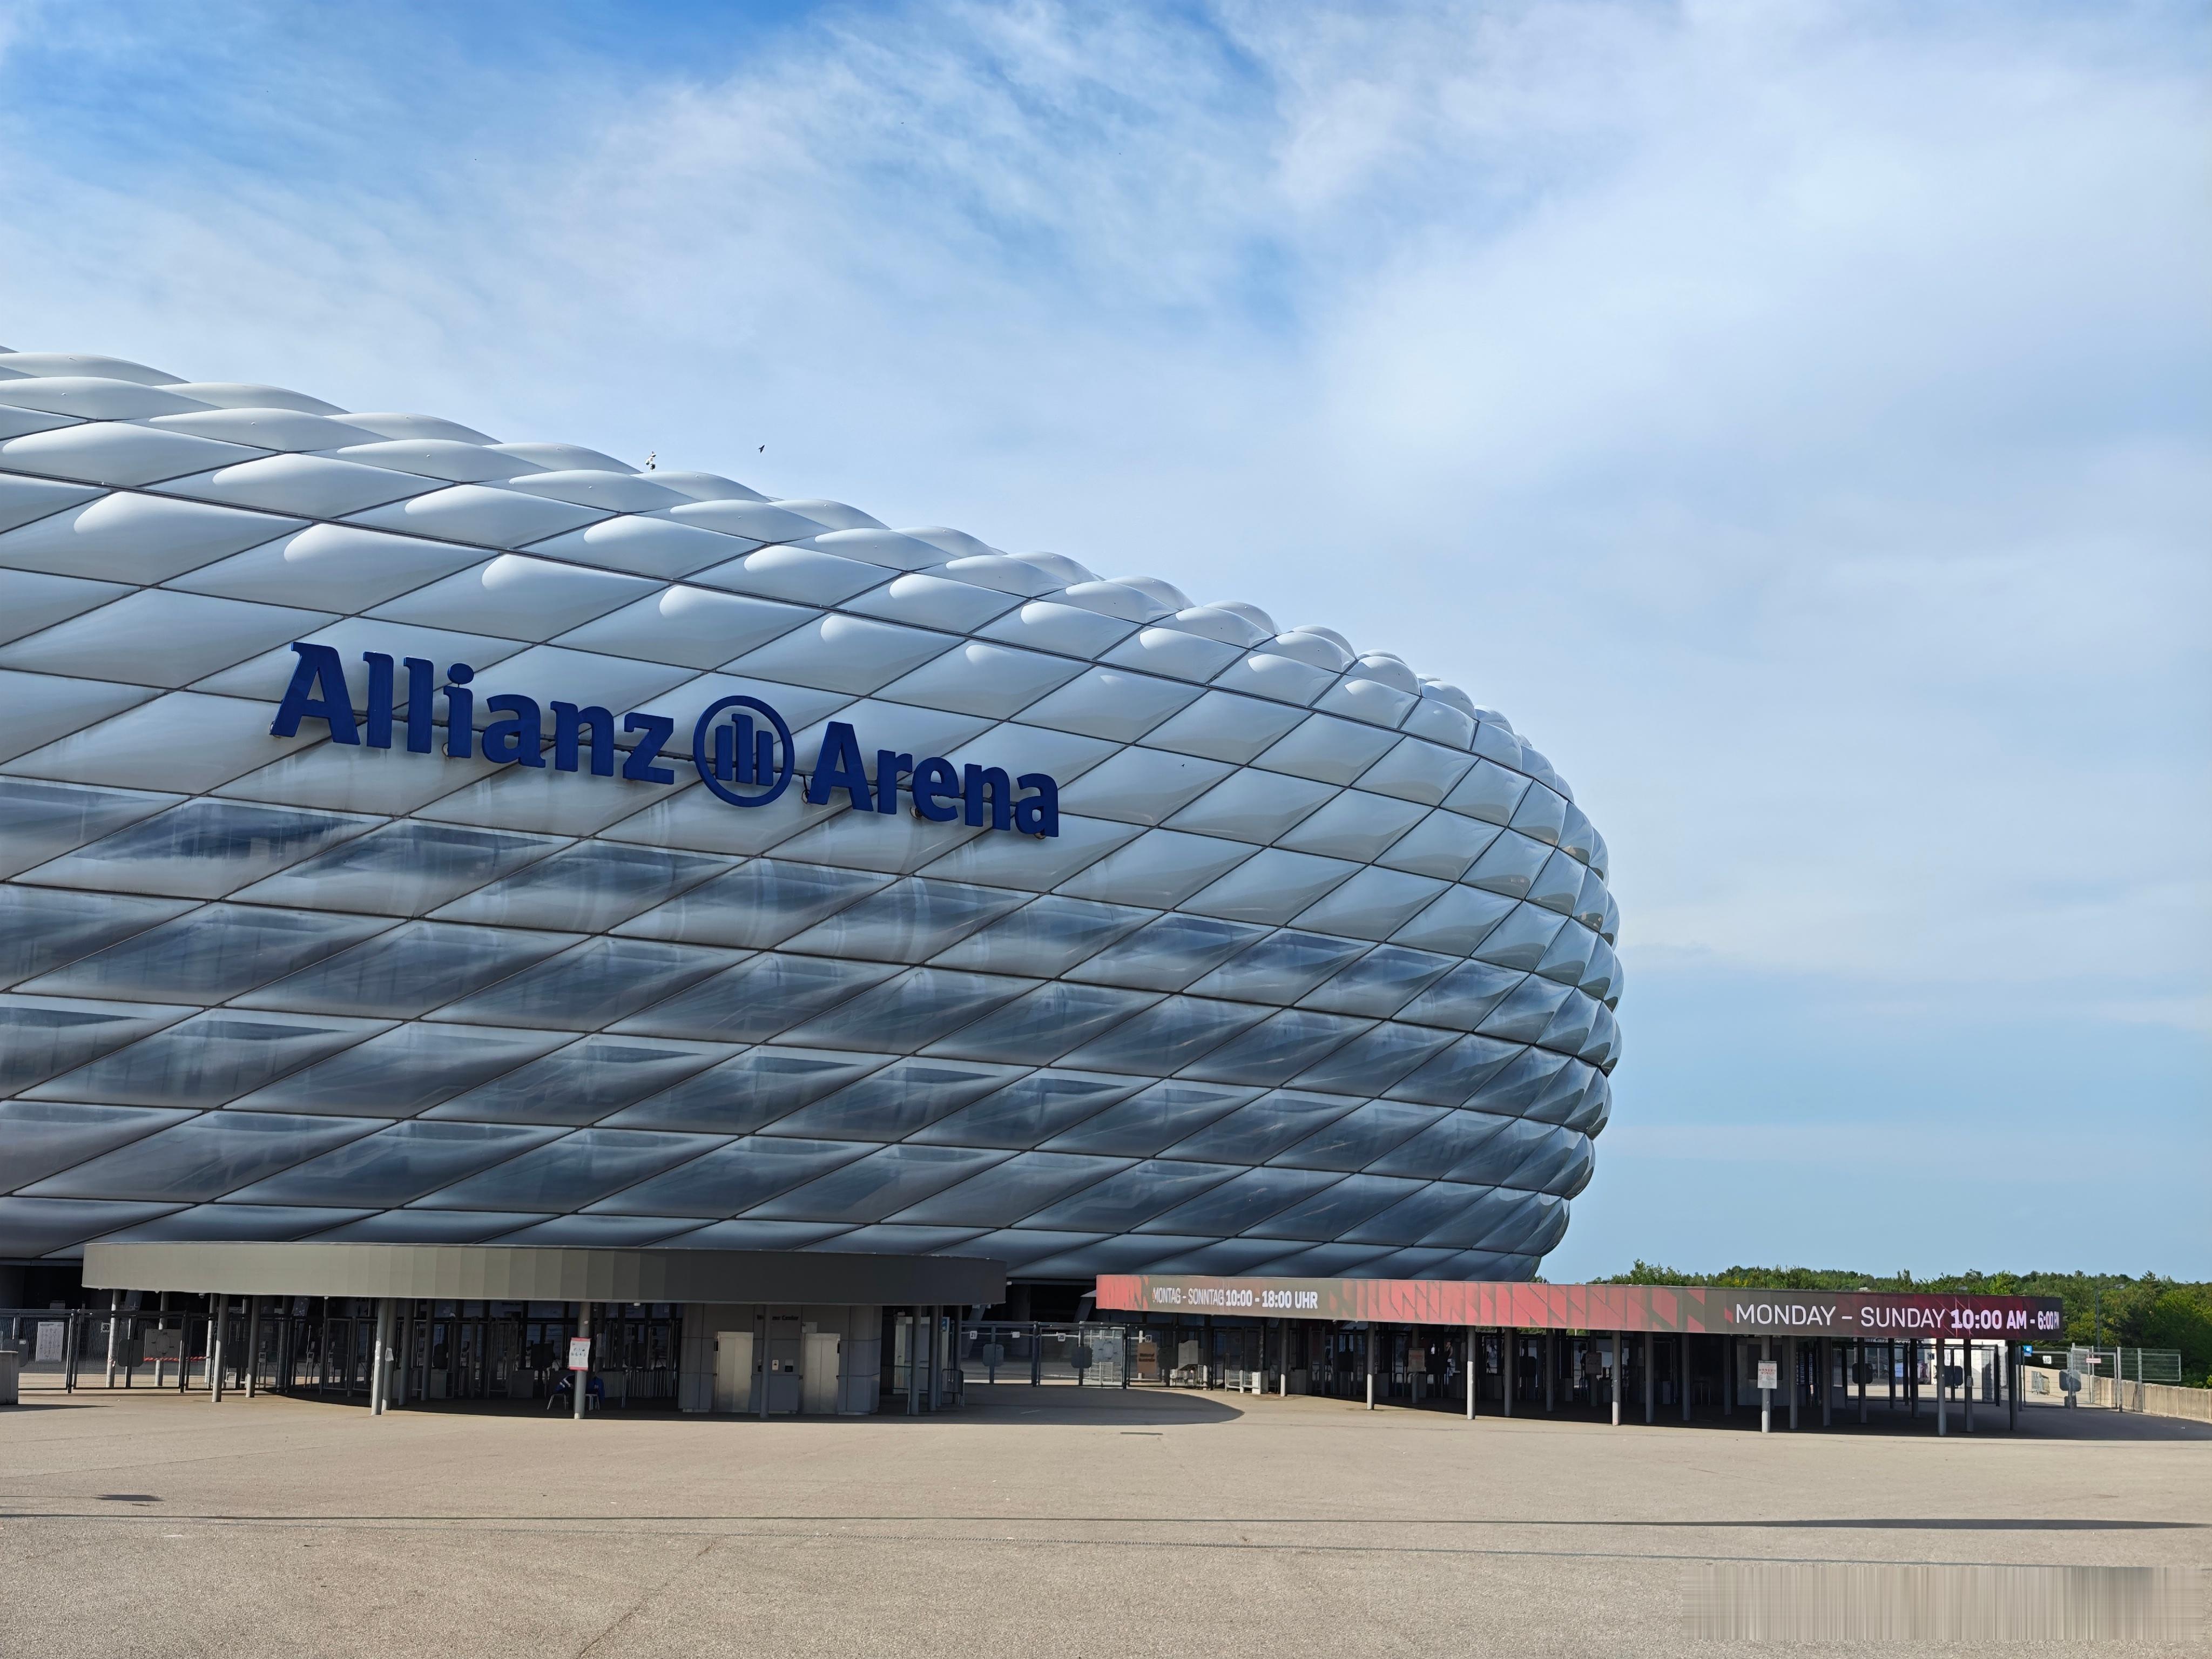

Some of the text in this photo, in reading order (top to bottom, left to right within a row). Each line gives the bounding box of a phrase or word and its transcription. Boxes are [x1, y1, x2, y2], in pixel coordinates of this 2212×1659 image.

[271, 641, 1059, 837] Allianz Arena
[1153, 1287, 1181, 1304] MONTAG
[1188, 1288, 1224, 1306] SONNTAG
[1226, 1289, 1252, 1307] 10:00
[1262, 1290, 1292, 1309] 18:00
[1295, 1291, 1318, 1309] UHR
[1736, 1303, 1837, 1326] MONDAY
[1861, 1306, 1945, 1328] SUNDAY
[1951, 1309, 2002, 1330] 10:00
[2006, 1310, 2027, 1330] AM
[2038, 1311, 2053, 1330] 6:00
[2054, 1311, 2060, 1329] PM
